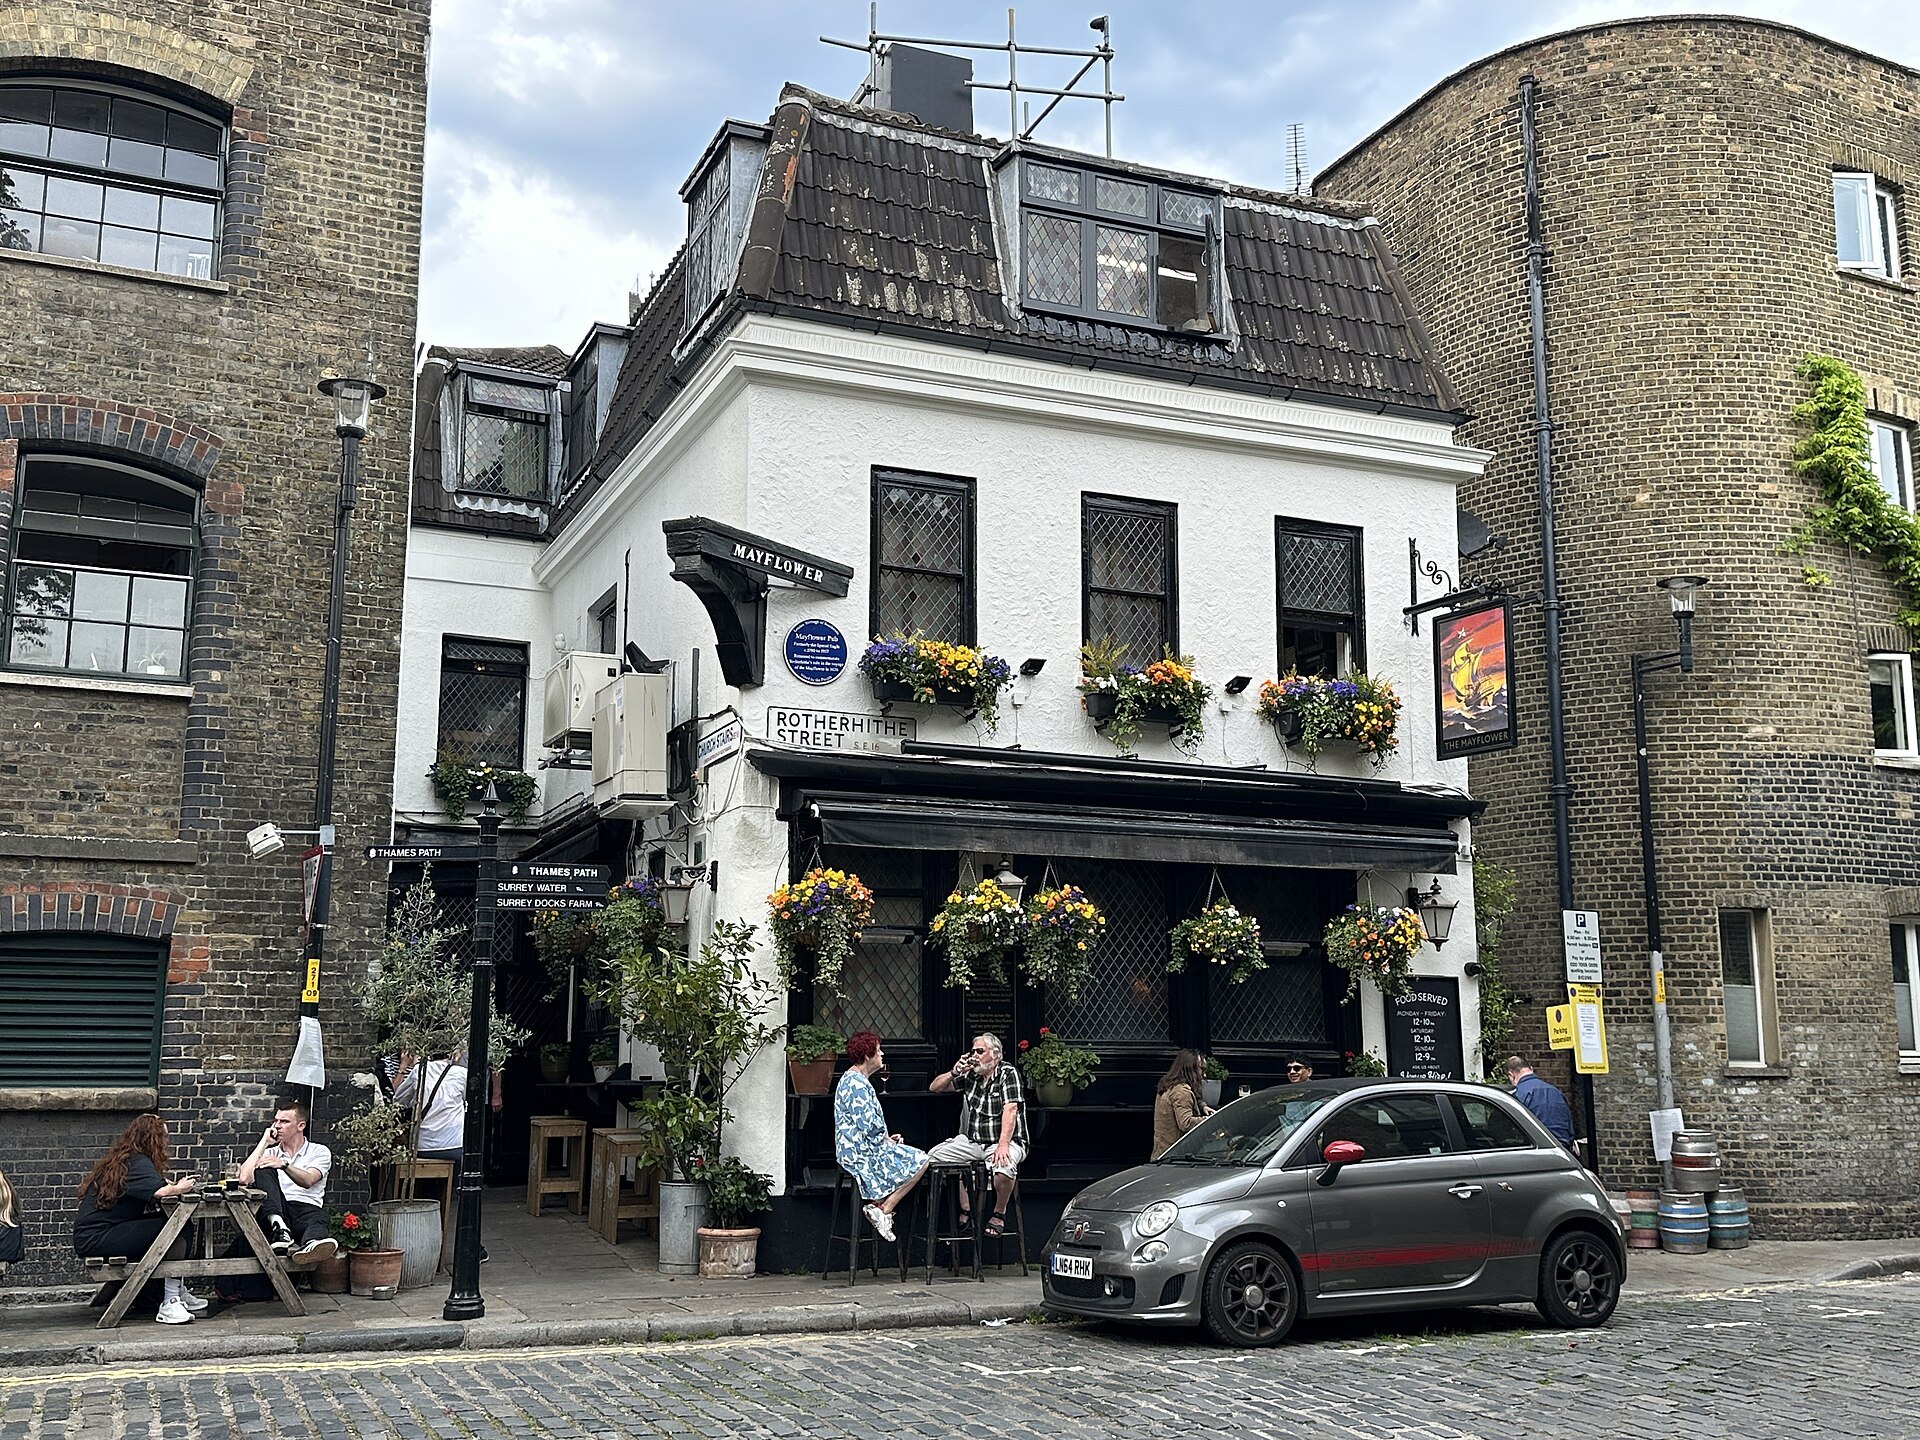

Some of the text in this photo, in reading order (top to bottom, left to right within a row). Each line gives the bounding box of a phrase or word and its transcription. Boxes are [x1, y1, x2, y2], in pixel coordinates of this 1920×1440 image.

[733, 543, 824, 583] MAYFLOWER
[796, 632, 826, 641] Mayflower
[776, 712, 908, 736] ROTHERHITHE
[778, 728, 845, 748] STREET
[1444, 732, 1509, 751] THE MAYFLOWER
[378, 848, 441, 858] THAMES PATH
[529, 866, 598, 878] THAMES PATH
[498, 883, 567, 893] SURREY WATER
[496, 898, 593, 908] SURREY DOCKS FARM
[1394, 992, 1448, 1006] FOOD SERVED
[1055, 1256, 1091, 1276] LN64 RHK
